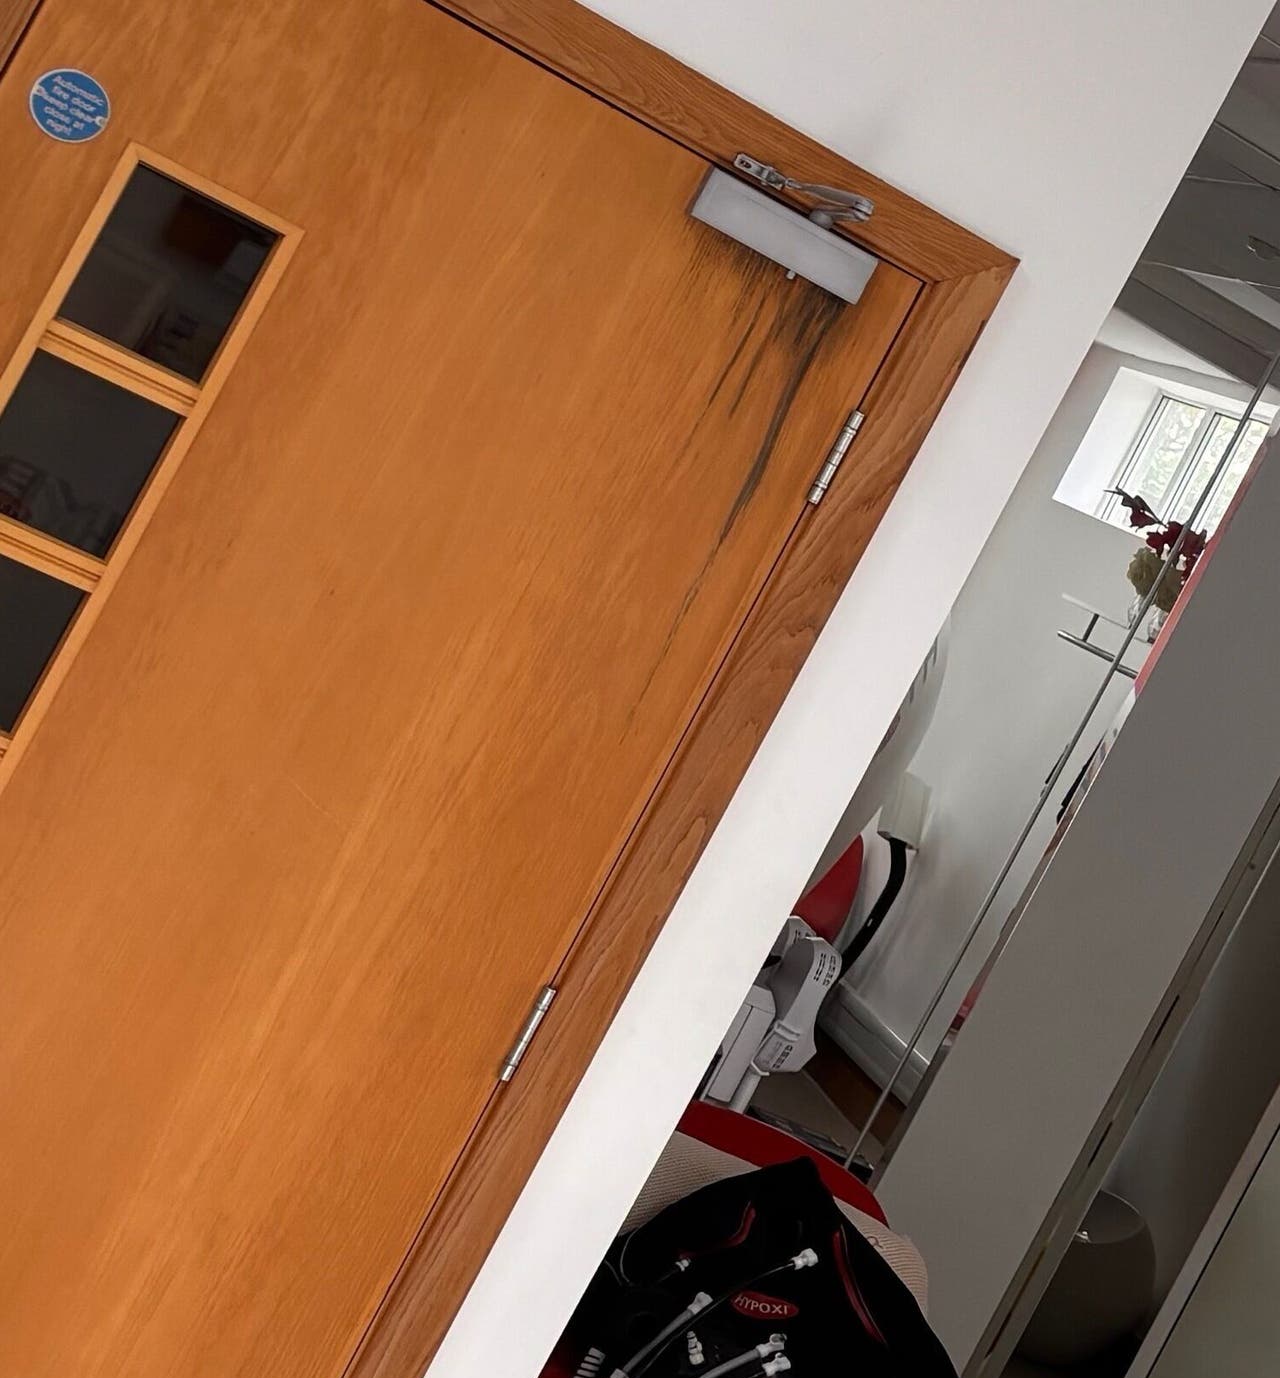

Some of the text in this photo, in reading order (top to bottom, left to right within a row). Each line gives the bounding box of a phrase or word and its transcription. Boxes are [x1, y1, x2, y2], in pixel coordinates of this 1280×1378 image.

[53, 76, 104, 106] Automatic
[71, 97, 97, 112] door
[734, 1293, 788, 1316] HYPOXI
